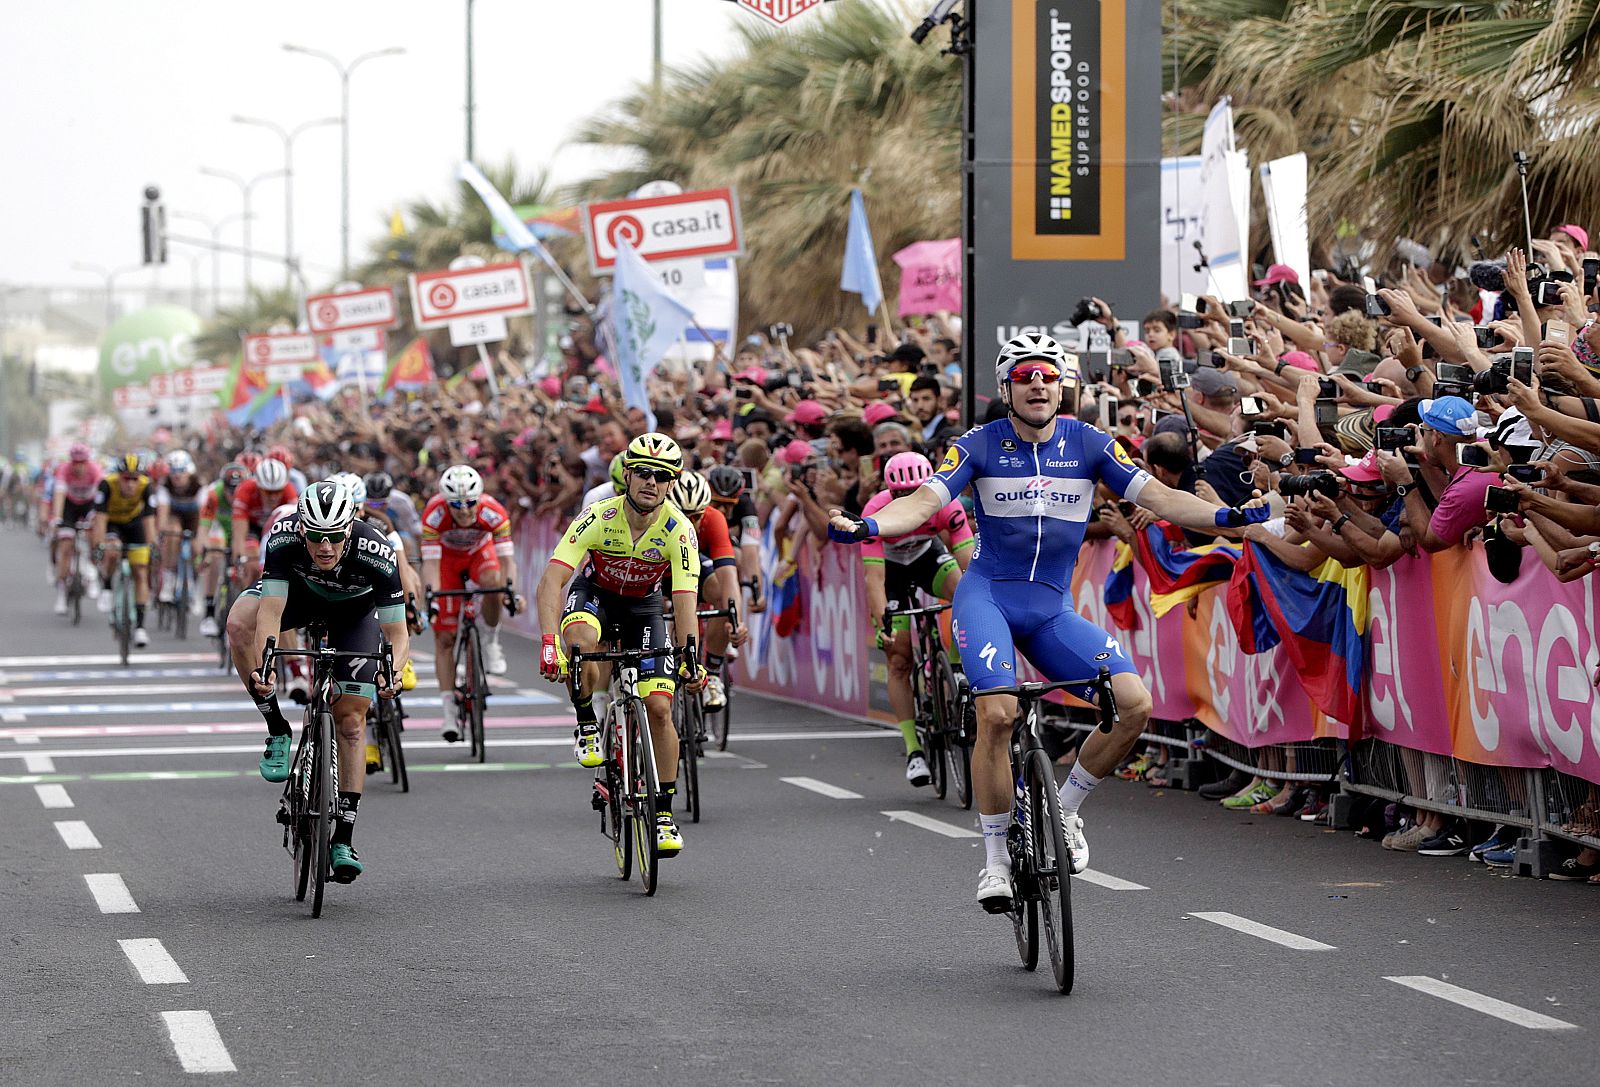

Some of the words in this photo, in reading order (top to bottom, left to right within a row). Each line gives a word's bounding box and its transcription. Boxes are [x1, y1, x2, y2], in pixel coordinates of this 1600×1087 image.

[1077, 61, 1090, 176] SUPERFOOD
[652, 210, 722, 238] casa.it
[462, 277, 517, 300] casa.it
[661, 269, 683, 286] 10
[111, 334, 197, 376] ene
[1045, 458, 1079, 468] latexco
[268, 534, 301, 549] hansgroh
[357, 537, 397, 567] BORA
[357, 551, 393, 575] hansgrohe
[642, 626, 652, 650] URSU
[1467, 572, 1600, 764] enel
[1447, 834, 1464, 847] N
